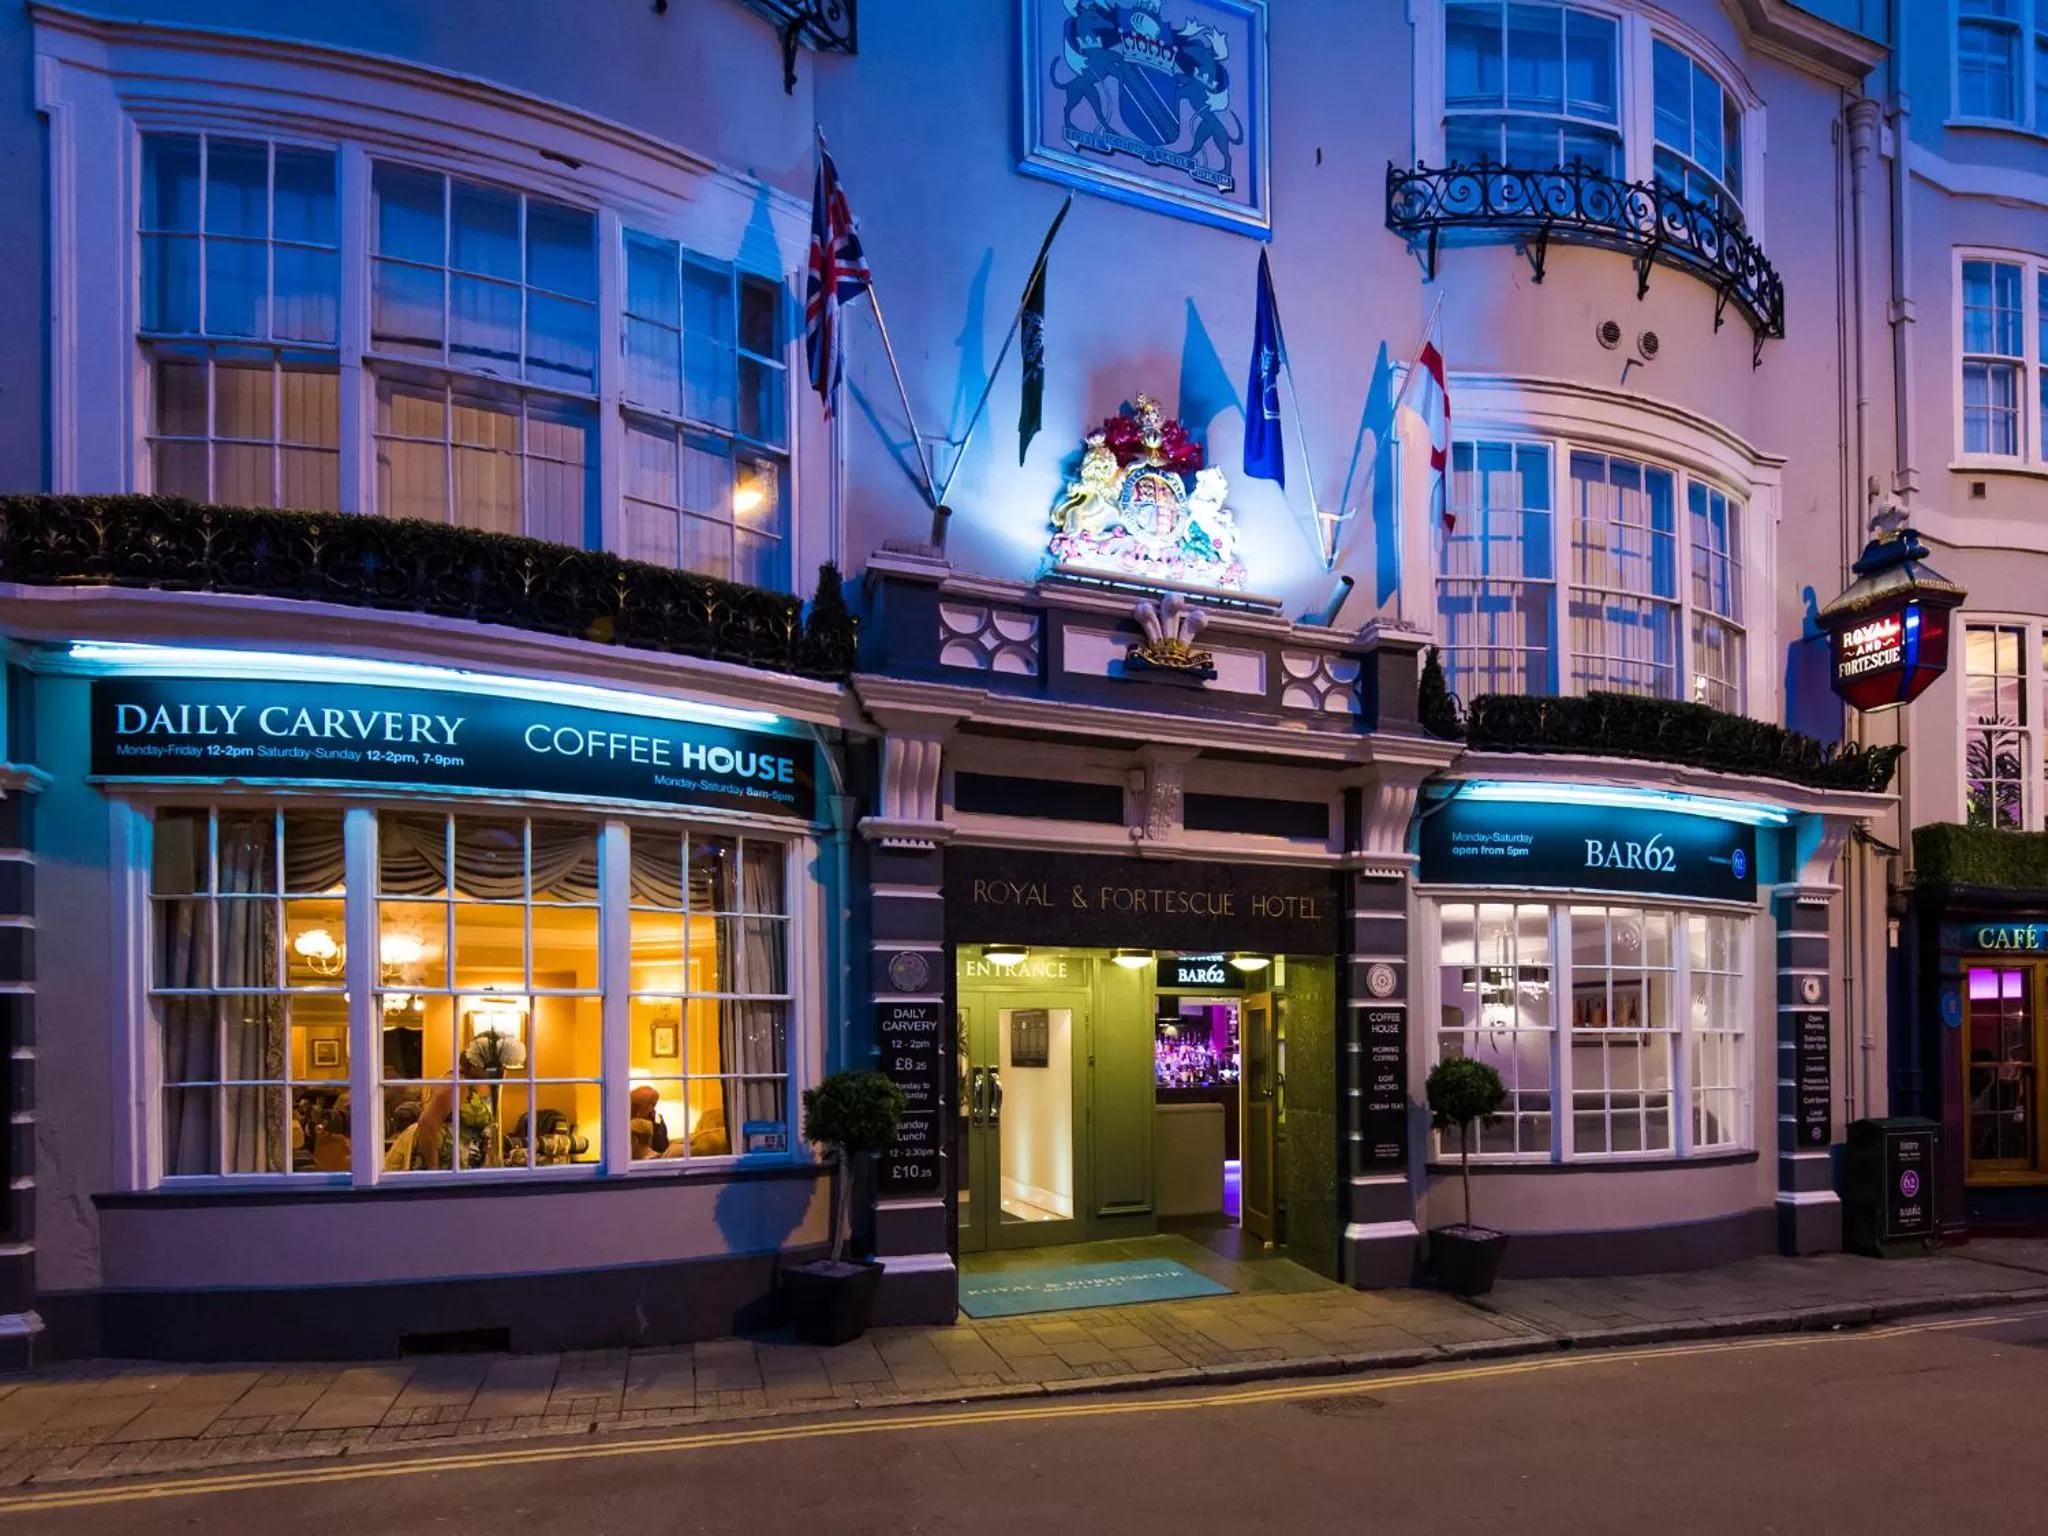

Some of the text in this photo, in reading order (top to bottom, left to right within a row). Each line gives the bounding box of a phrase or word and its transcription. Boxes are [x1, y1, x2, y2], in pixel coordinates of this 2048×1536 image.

[1843, 618, 1898, 648] ROYAL
[1855, 640, 1883, 656] AND
[1838, 647, 1901, 678] FORTESCUE
[115, 704, 466, 745] DAILY CARVERY
[117, 744, 465, 767] Monday-Friday 12-2pm Saturday-Sunday 12-2pm, 7-9pm
[524, 724, 795, 783] COFFEE HOUSE
[654, 774, 794, 803] Monday-Saturday 8am-5pm
[1452, 845, 1529, 858] open from 5pm
[1452, 831, 1677, 873] Monday-Saturday BAR62
[974, 879, 1323, 920] ROYAL & FORTESCUE HOTEL
[1978, 924, 2039, 950] CAFÉ
[966, 960, 1067, 979] ENTRANCE
[1178, 964, 1226, 983] BAR62
[894, 1008, 926, 1019] DAILY
[1369, 1012, 1401, 1022] COFFEE
[882, 1021, 937, 1032] CARVERY
[1372, 1023, 1399, 1033] HOUSE
[892, 1040, 902, 1049] 12
[910, 1040, 930, 1050] 2pm
[896, 1131, 926, 1141] Lunch
